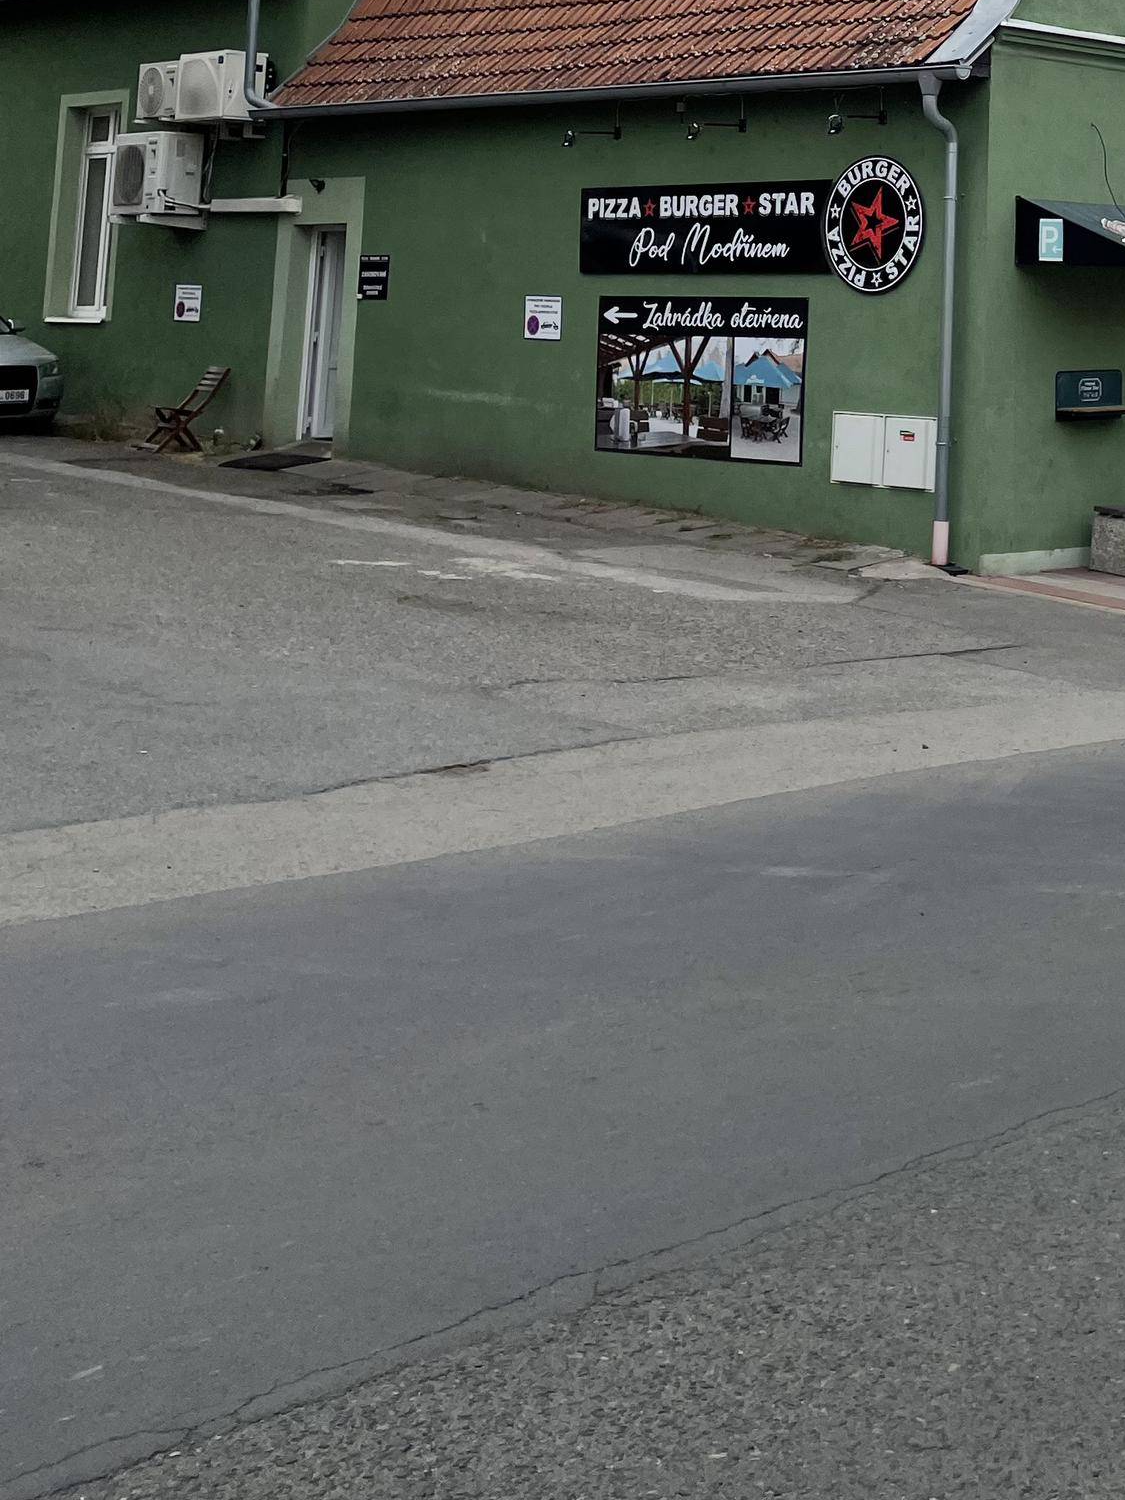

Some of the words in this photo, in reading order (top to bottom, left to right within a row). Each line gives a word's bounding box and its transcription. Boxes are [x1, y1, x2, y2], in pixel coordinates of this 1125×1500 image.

[837, 161, 911, 198] BURGER
[587, 197, 642, 219] PIZZA
[659, 194, 739, 217] BURGER
[758, 192, 815, 216] STAR
[628, 227, 676, 267] Pod
[681, 222, 790, 265] Modřínem
[827, 226, 867, 288] PIZZA
[884, 215, 920, 281] STAR
[1042, 226, 1058, 253] P
[642, 301, 725, 331] Zahrádka
[730, 302, 804, 330] otevřena
